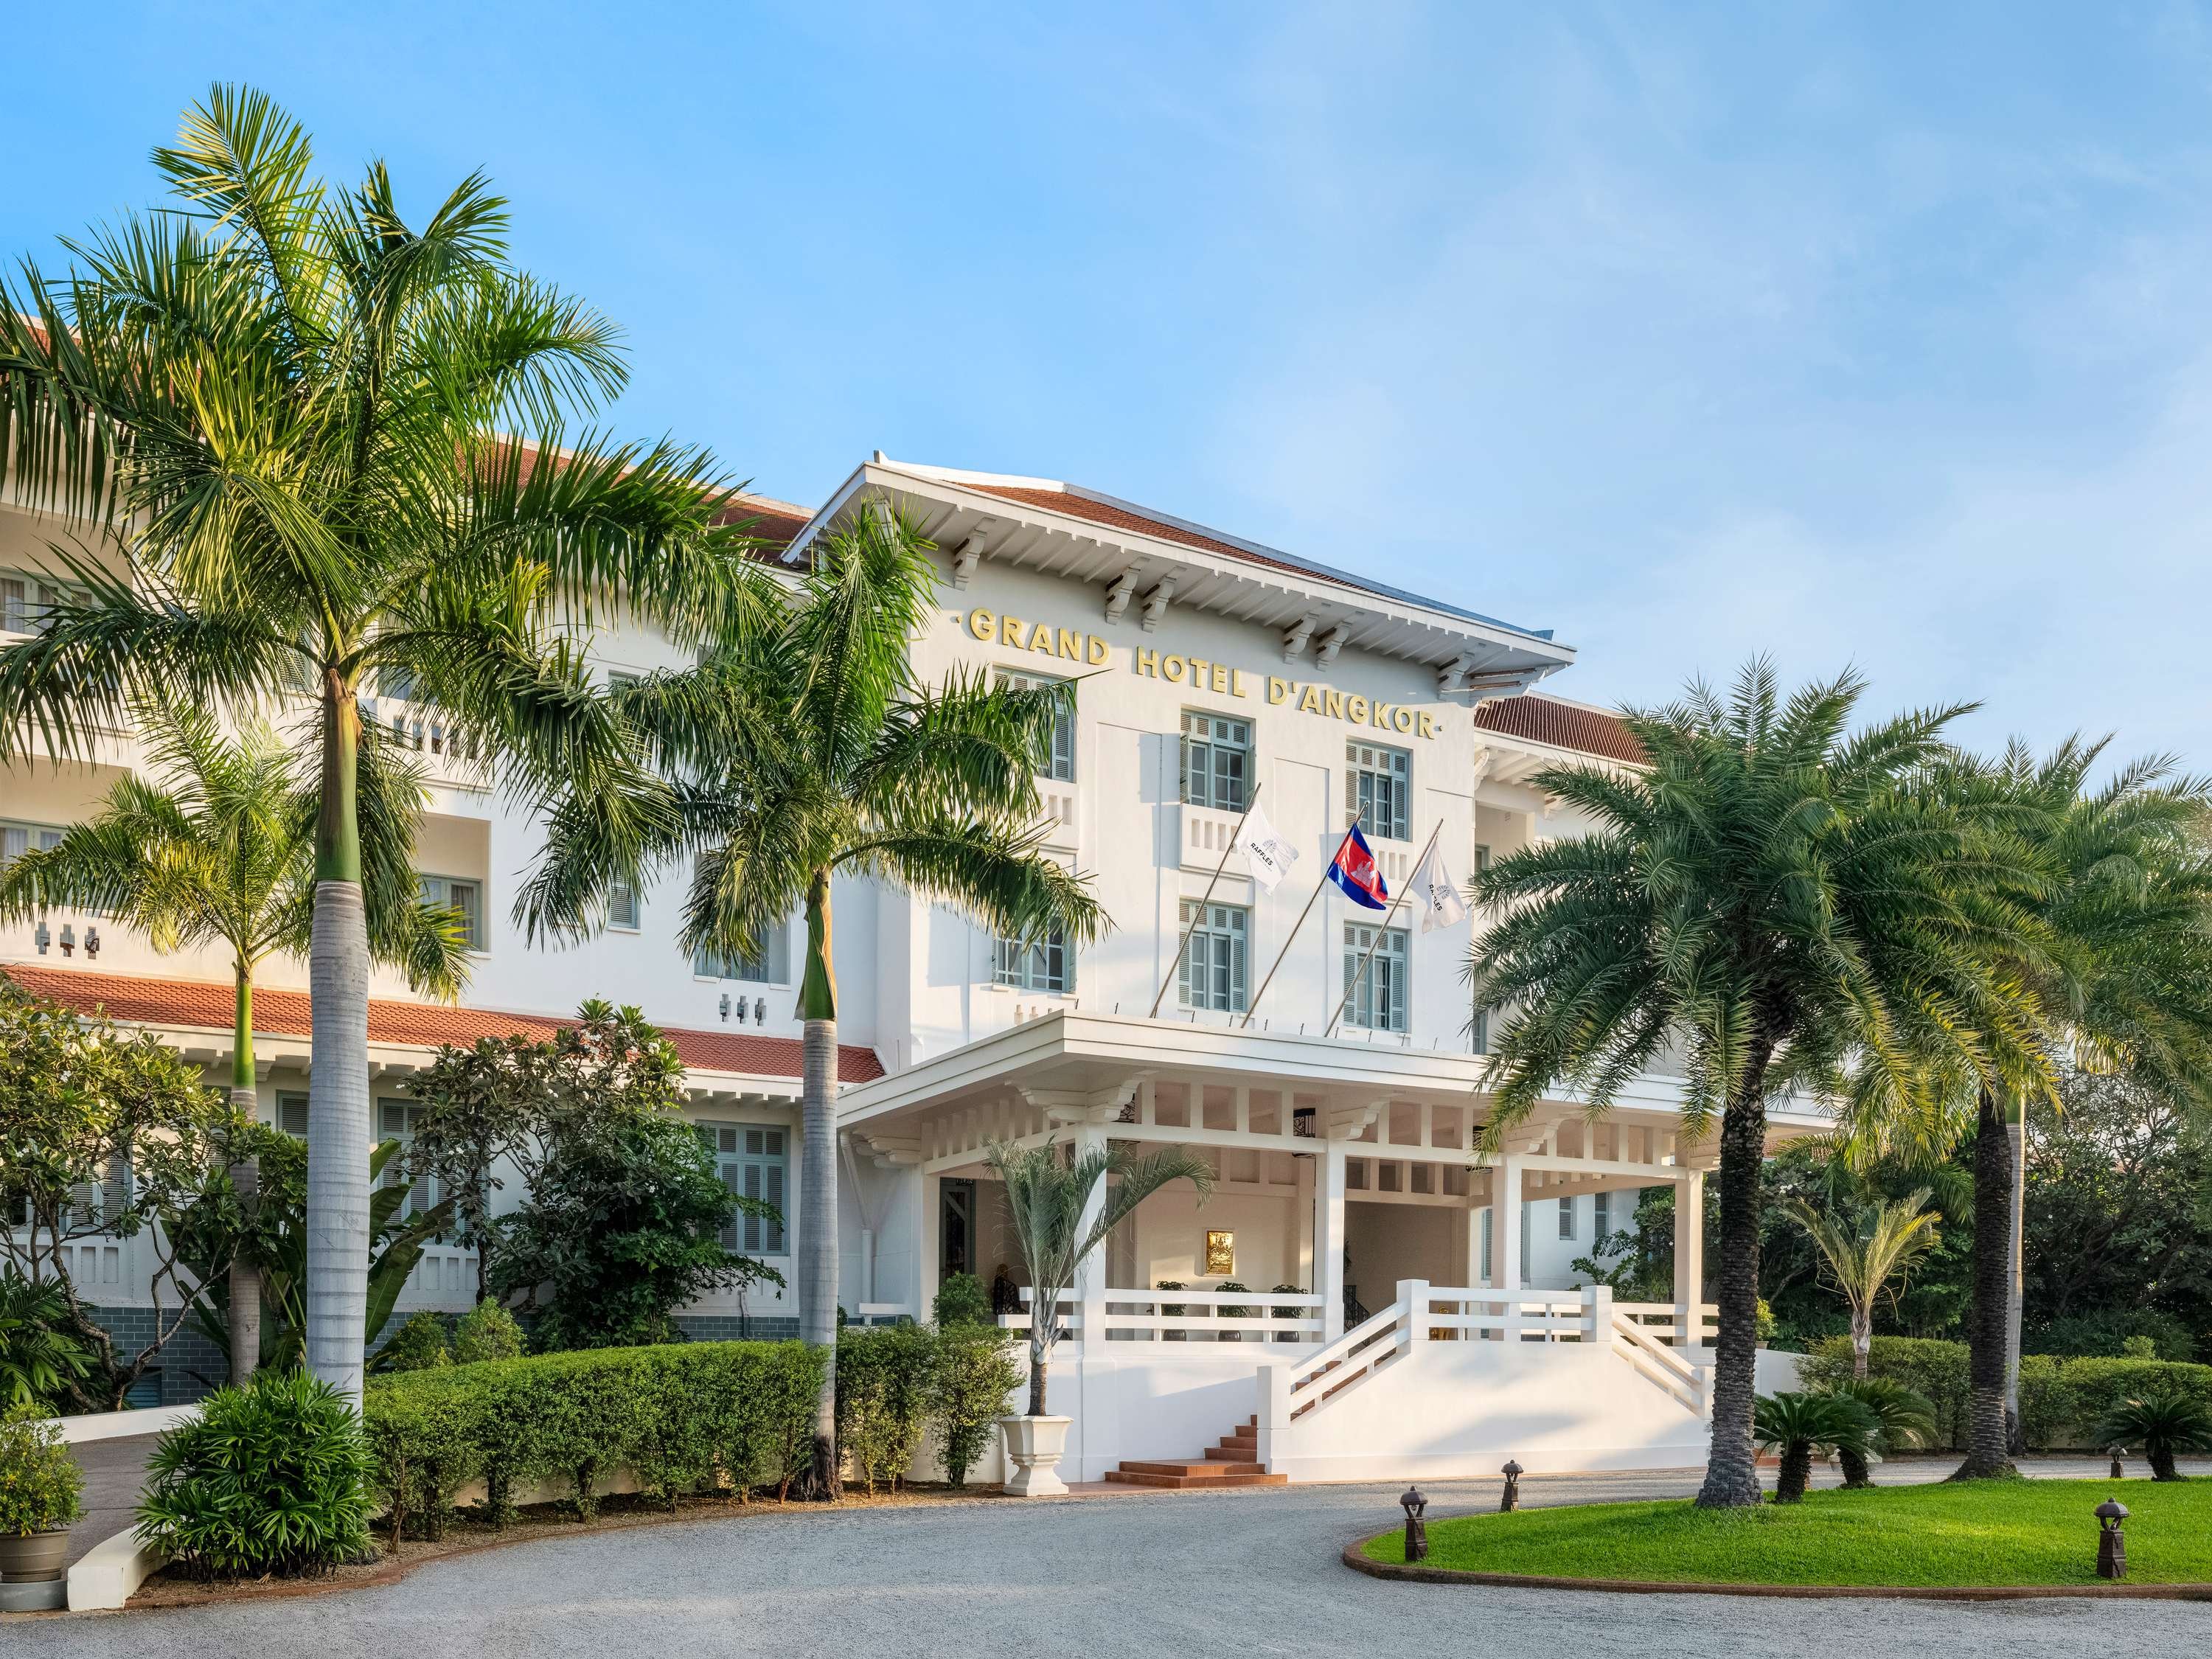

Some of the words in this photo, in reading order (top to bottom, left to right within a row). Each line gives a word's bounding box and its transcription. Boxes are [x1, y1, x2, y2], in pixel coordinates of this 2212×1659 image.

[970, 607, 1109, 665] GRAND
[1137, 646, 1246, 698] HOTEL
[1268, 675, 1435, 740] D'ANGKOR
[1251, 843, 1273, 866] RAFFLES
[1428, 884, 1443, 911] RALES
